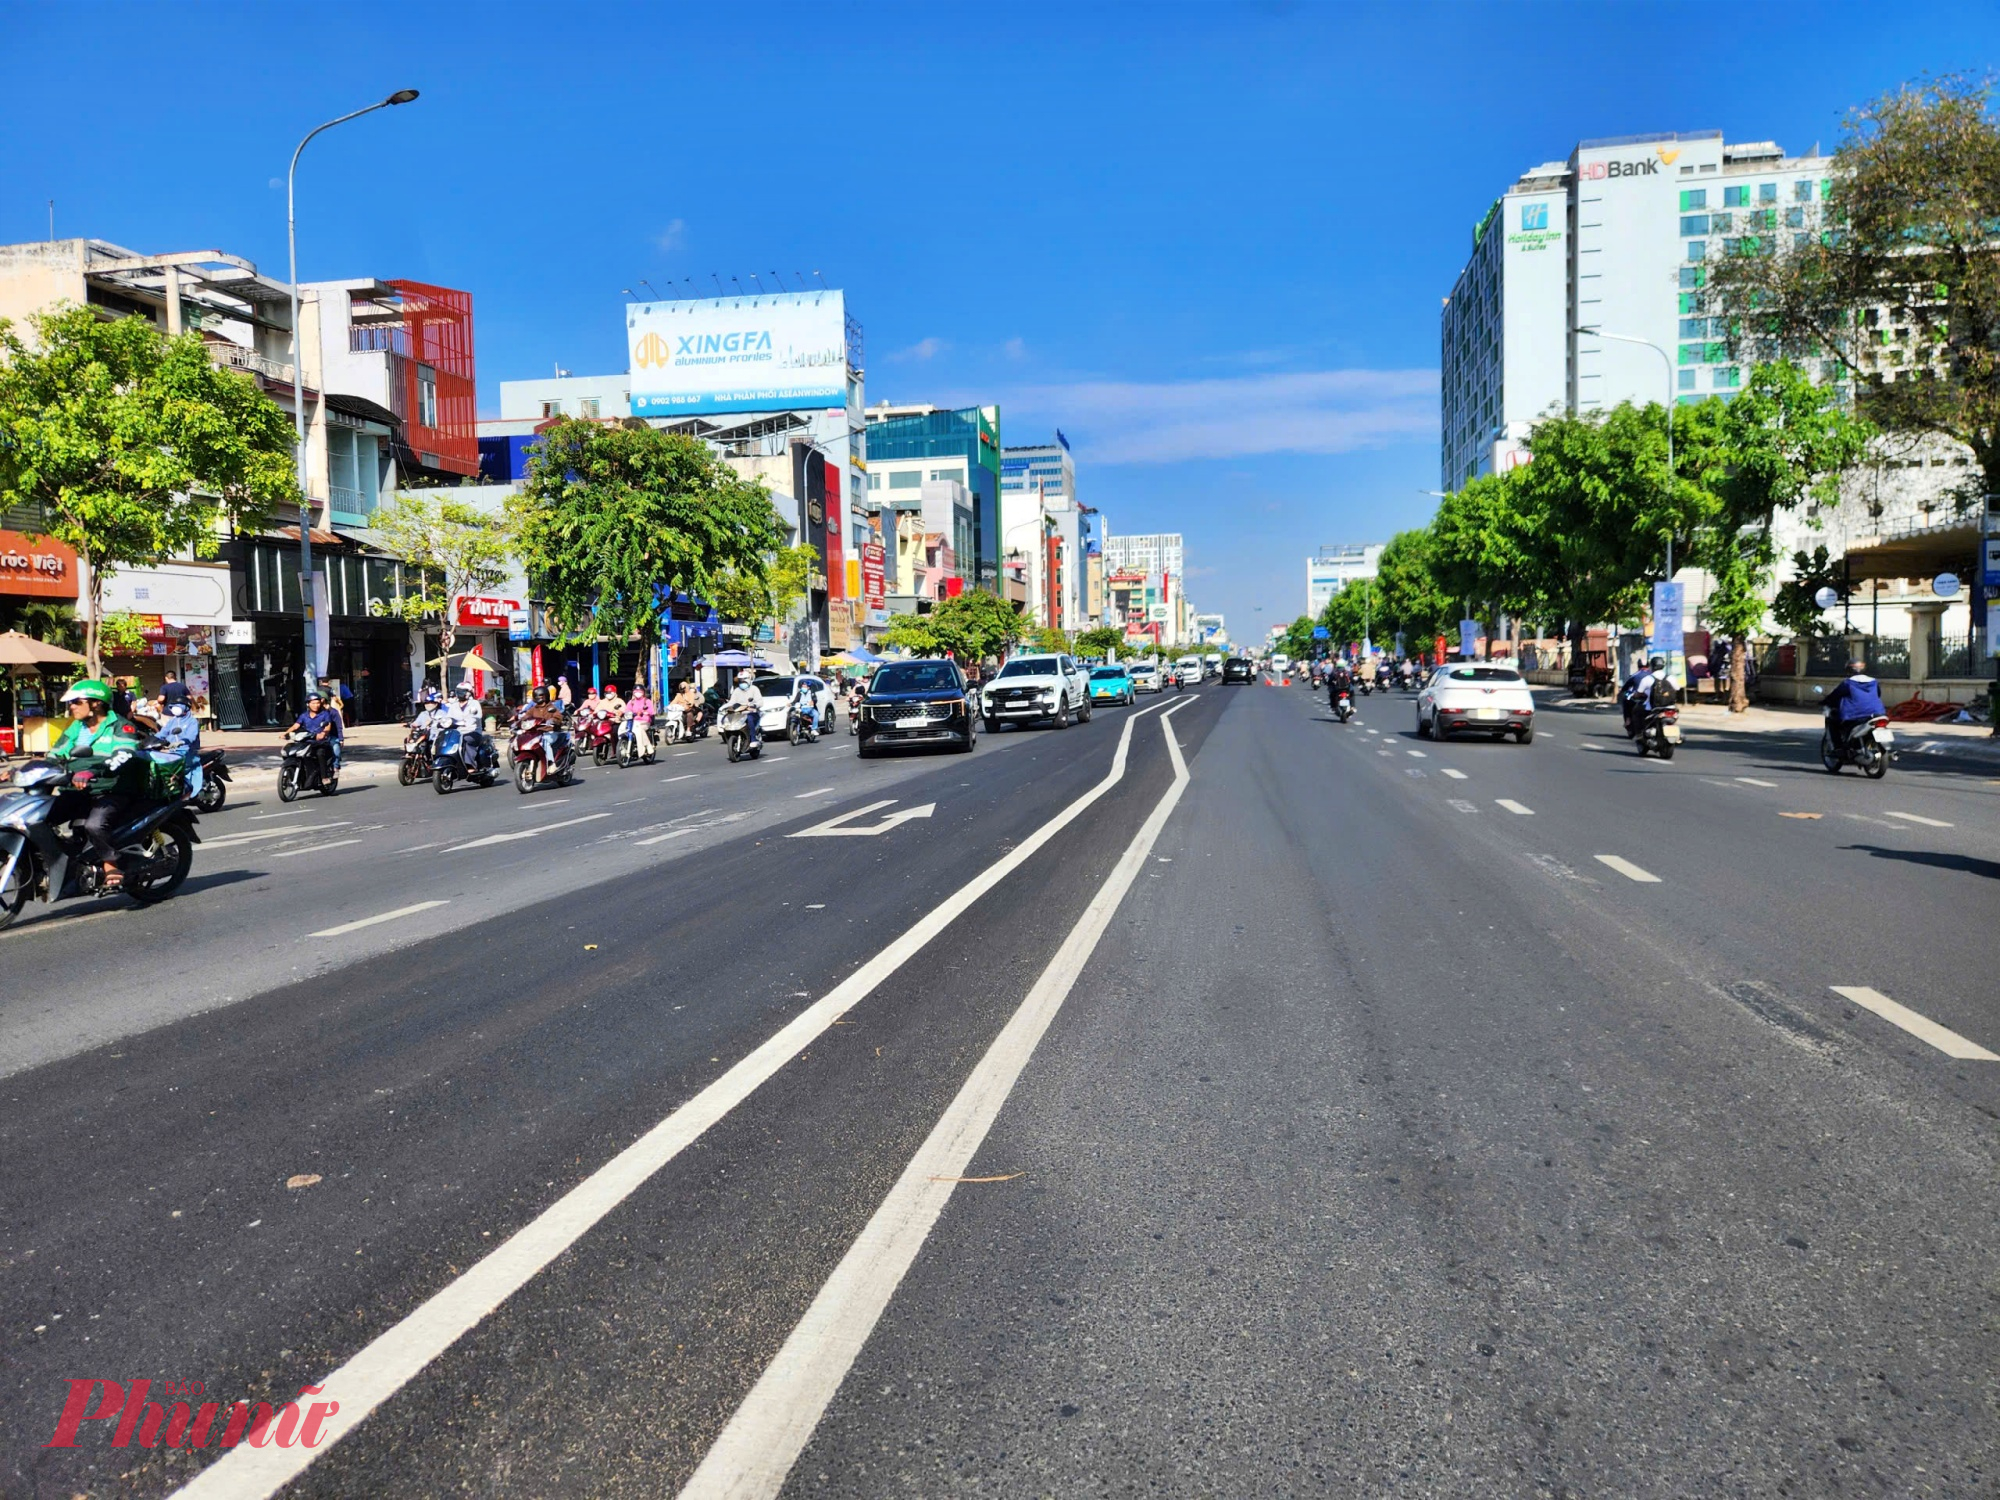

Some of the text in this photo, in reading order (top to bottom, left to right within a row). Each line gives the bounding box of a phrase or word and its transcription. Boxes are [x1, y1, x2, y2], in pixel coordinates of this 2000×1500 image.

[1578, 157, 1658, 181] HDBank
[1508, 232, 1544, 244] Holiday
[675, 331, 772, 355] XINGFA
[29, 553, 63, 575] Việt
[219, 629, 249, 637] OWEN
